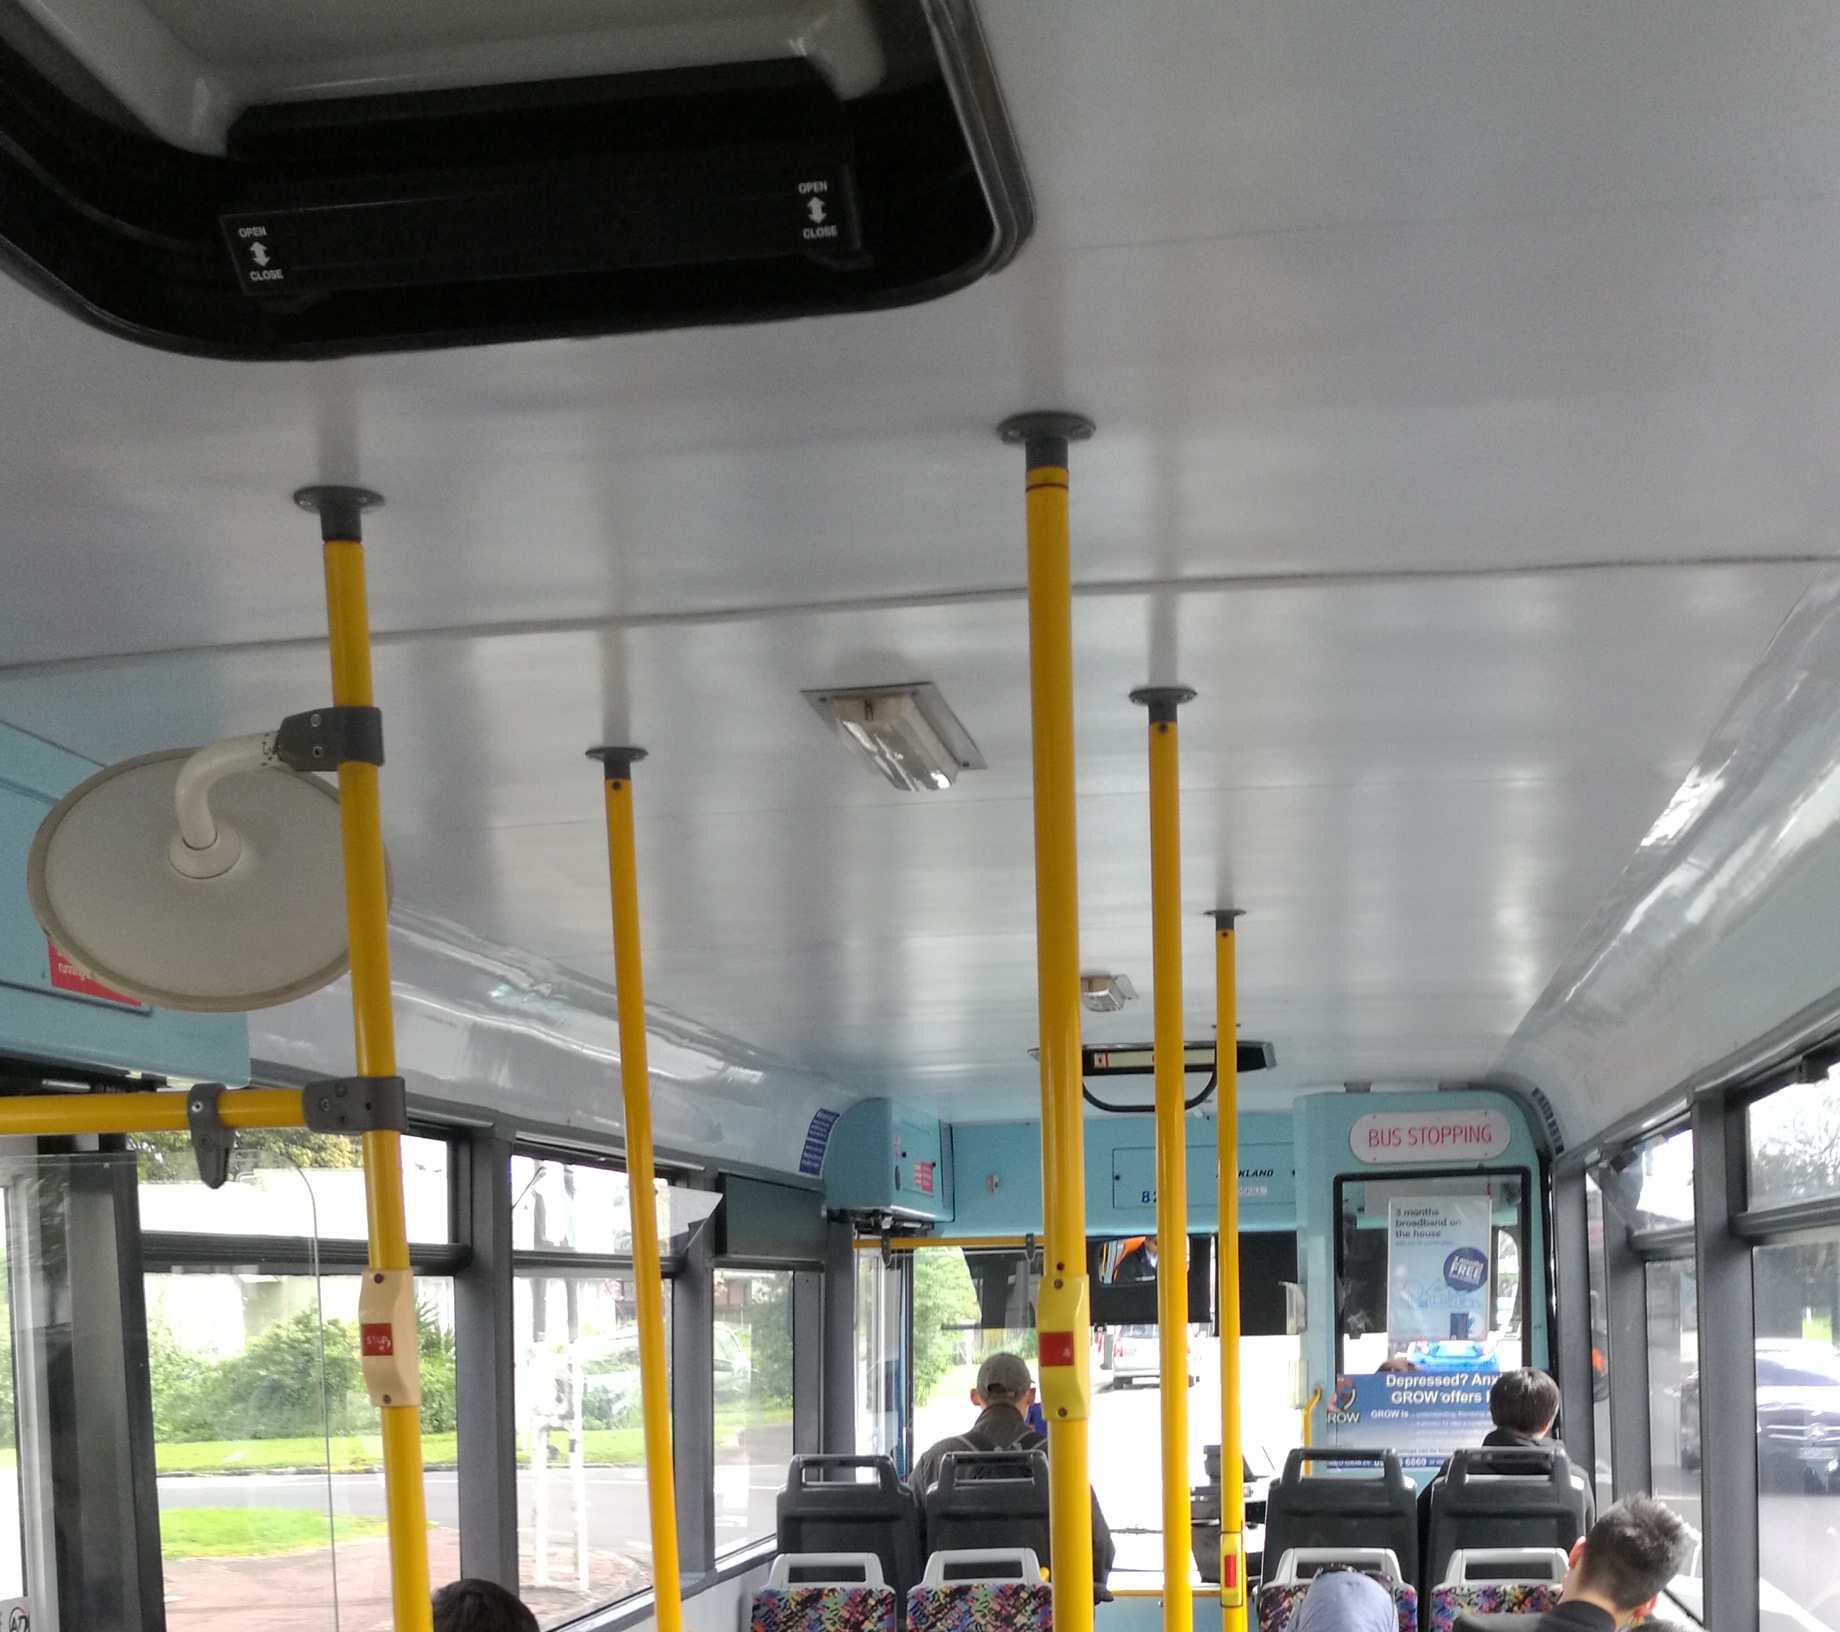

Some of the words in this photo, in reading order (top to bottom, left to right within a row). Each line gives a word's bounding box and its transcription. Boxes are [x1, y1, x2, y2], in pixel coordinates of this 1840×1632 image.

[798, 181, 828, 194] OPEN
[239, 226, 267, 238] OPEN
[803, 225, 838, 239] CLOSE
[249, 268, 284, 282] CLOSE
[1368, 1128, 1402, 1147] BUS
[1408, 1124, 1492, 1145] STOPPING
[1404, 1207, 1440, 1216] months
[1395, 1217, 1447, 1227] broadband
[1395, 1229, 1411, 1238] the
[1413, 1229, 1442, 1238] house
[1386, 1373, 1469, 1389] Depressed?
[1392, 1391, 1438, 1404] GROW
[1441, 1390, 1482, 1404] offers
[1327, 1411, 1360, 1424] ROW
[1370, 1409, 1400, 1419] GROW
[1401, 1409, 1409, 1418] is
